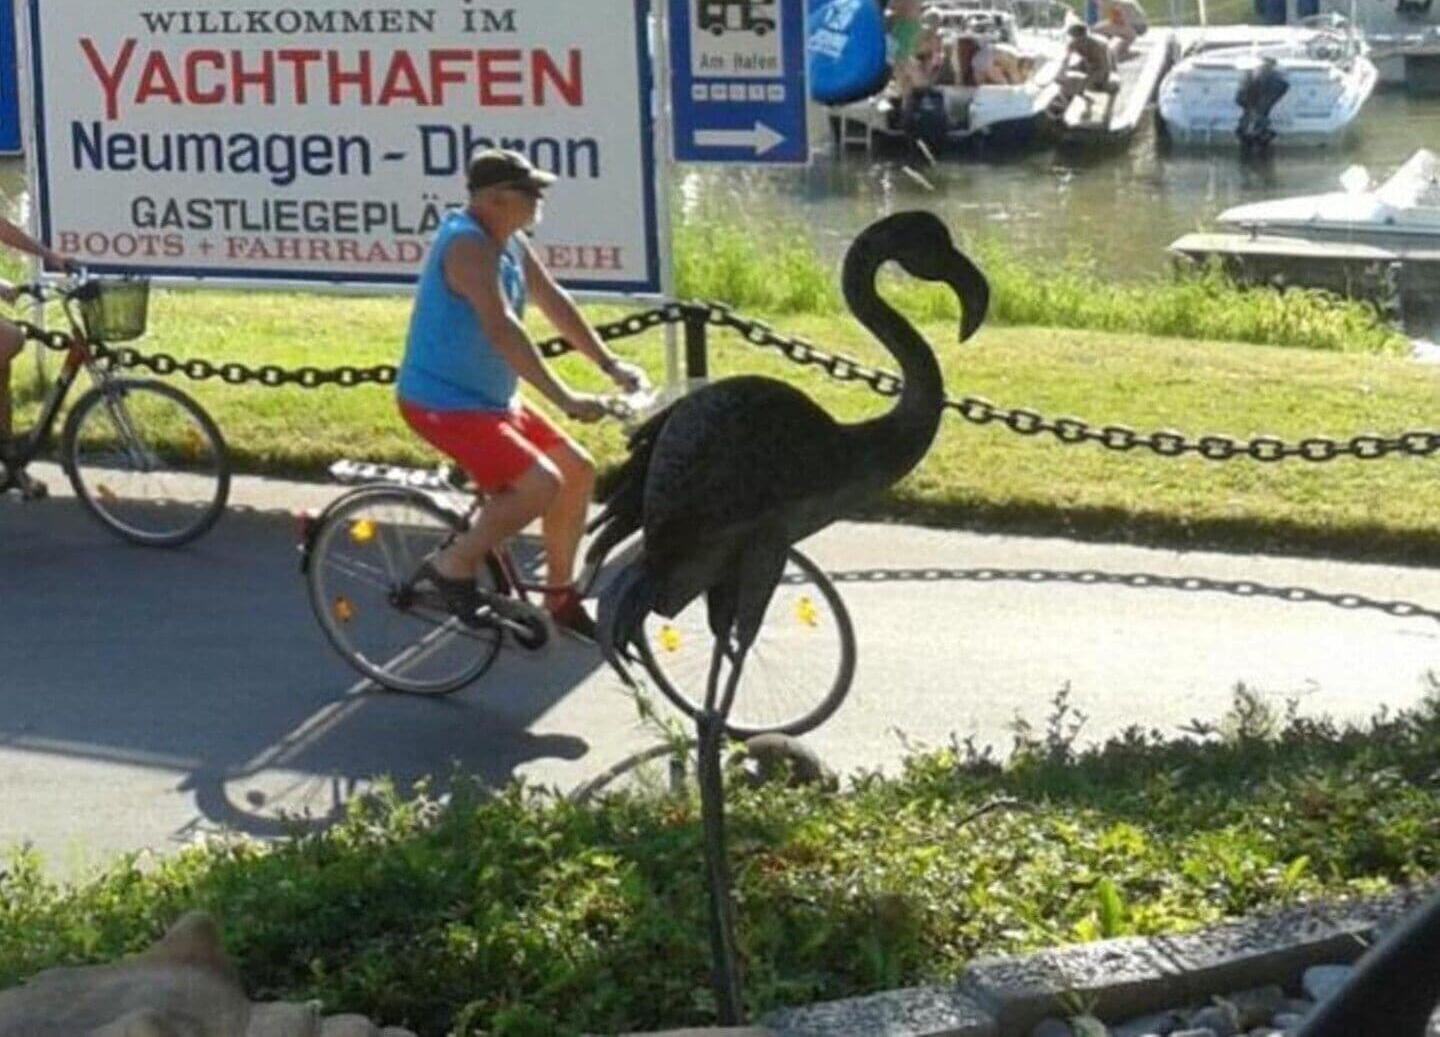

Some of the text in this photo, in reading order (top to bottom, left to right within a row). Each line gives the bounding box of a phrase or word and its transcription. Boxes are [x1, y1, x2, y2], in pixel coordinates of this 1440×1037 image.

[141, 9, 437, 34] WILLKOMMEN
[78, 38, 584, 120] YACHTHAFEN
[131, 193, 534, 238] GASTLIEGEPLÄ
[58, 232, 184, 257] BOOTS
[227, 236, 624, 270] FAHRRADEIH
